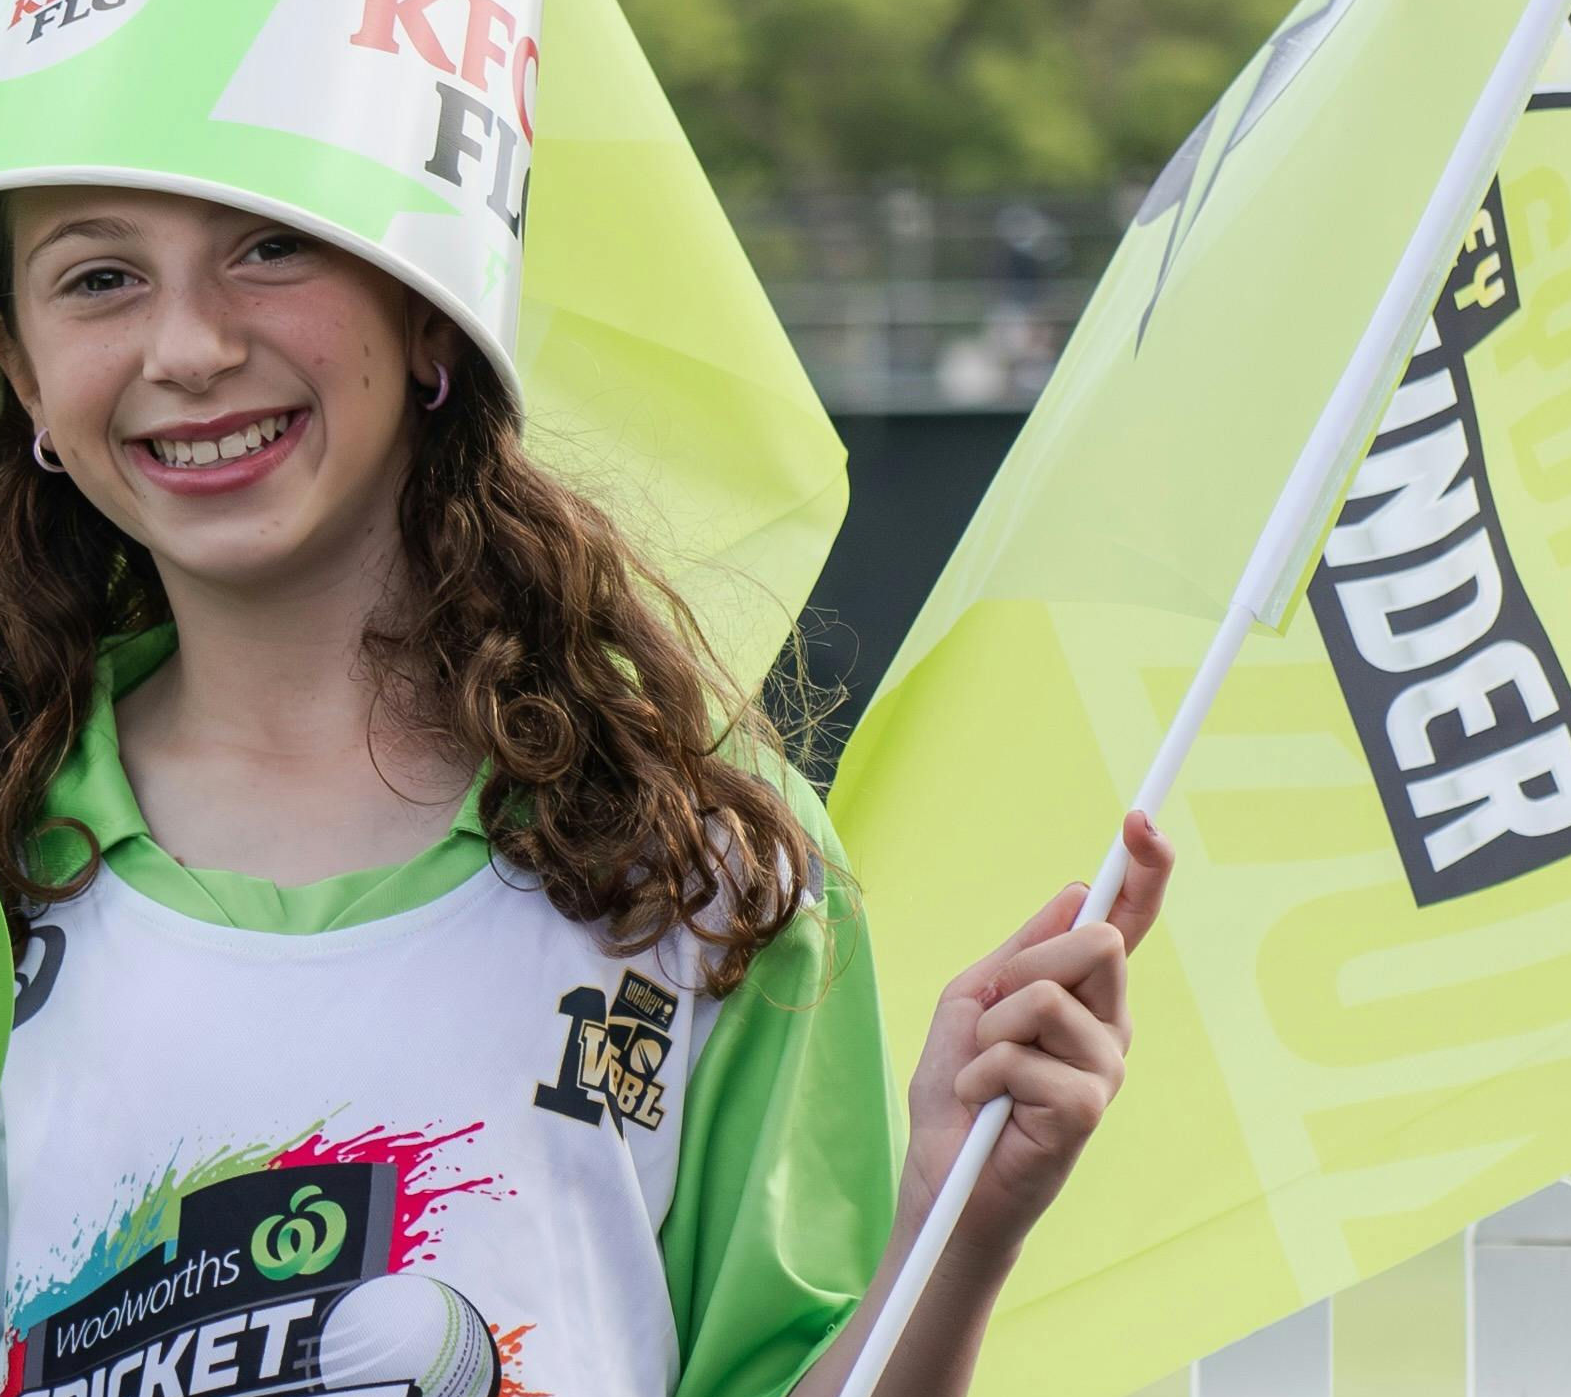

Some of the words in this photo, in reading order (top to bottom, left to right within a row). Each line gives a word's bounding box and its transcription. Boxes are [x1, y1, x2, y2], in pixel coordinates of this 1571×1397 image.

[425, 80, 530, 253] FL
[624, 979, 664, 1016] weber
[56, 1248, 240, 1358] Woolworths
